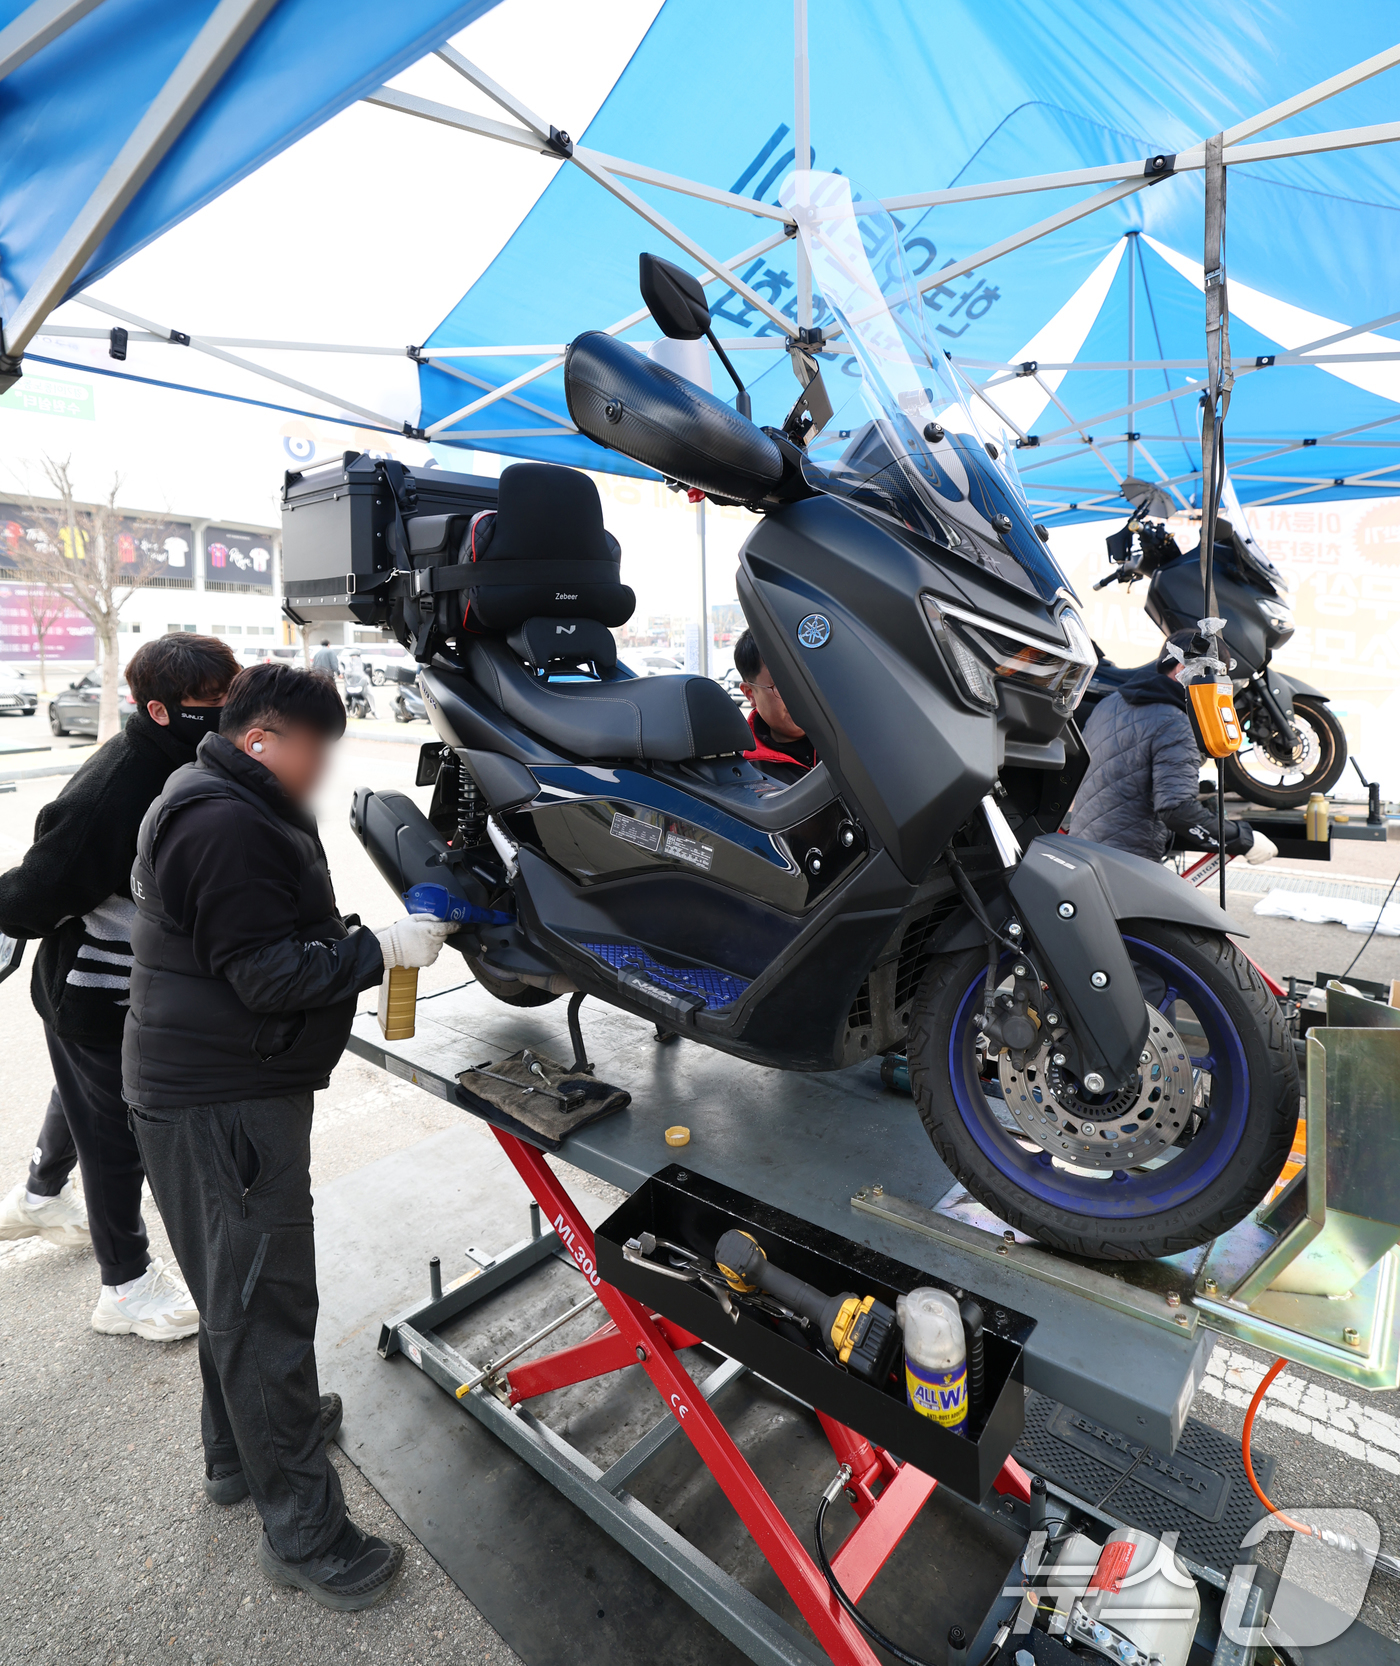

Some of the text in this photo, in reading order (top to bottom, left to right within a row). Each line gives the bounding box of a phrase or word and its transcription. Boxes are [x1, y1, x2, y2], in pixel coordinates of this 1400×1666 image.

[554, 592, 578, 601] Zebeer
[1191, 857, 1220, 883] BRIGH
[553, 1213, 600, 1287] ML300
[913, 1384, 939, 1406] ALL
[1068, 1412, 1209, 1492] BRIGHT
